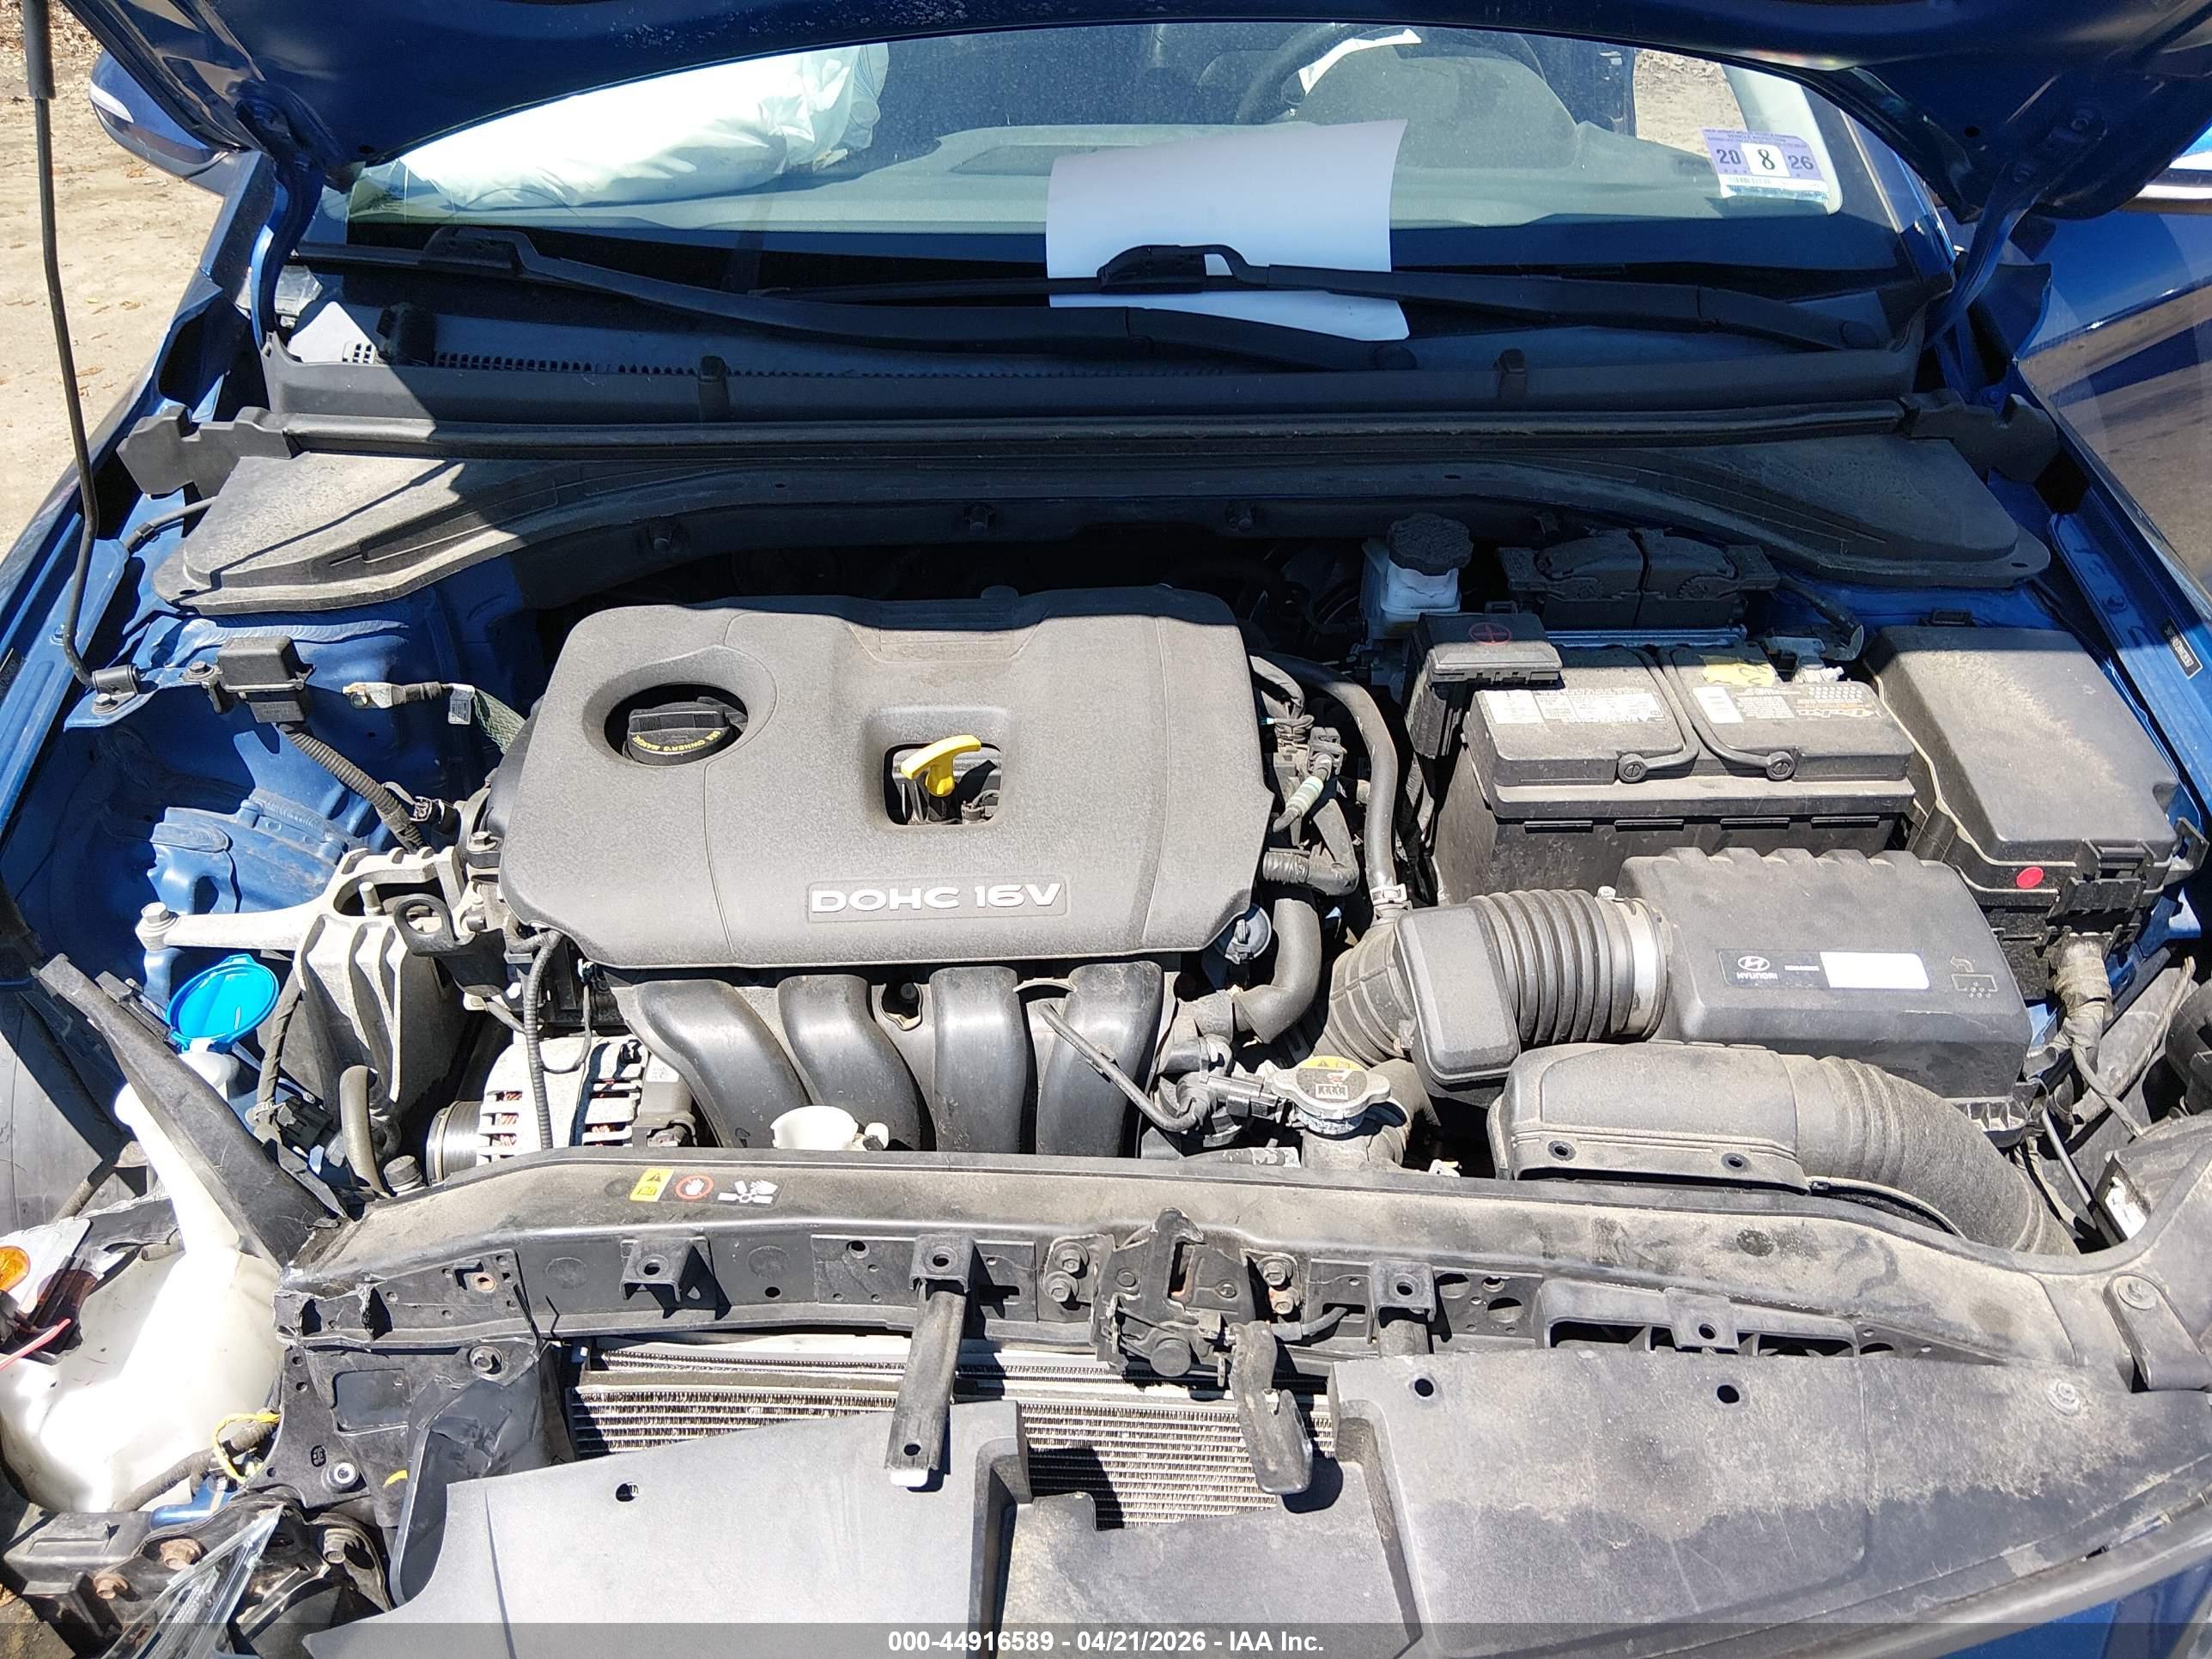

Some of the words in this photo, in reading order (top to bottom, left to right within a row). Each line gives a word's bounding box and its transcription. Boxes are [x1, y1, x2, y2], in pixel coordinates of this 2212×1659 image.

[1717, 149, 1742, 166] 20
[1758, 149, 1776, 170] 8
[1788, 155, 1814, 170] 26
[811, 885, 961, 914] DOHC
[974, 883, 1061, 908] 16V
[1736, 971, 1778, 980] HYUNDAI
